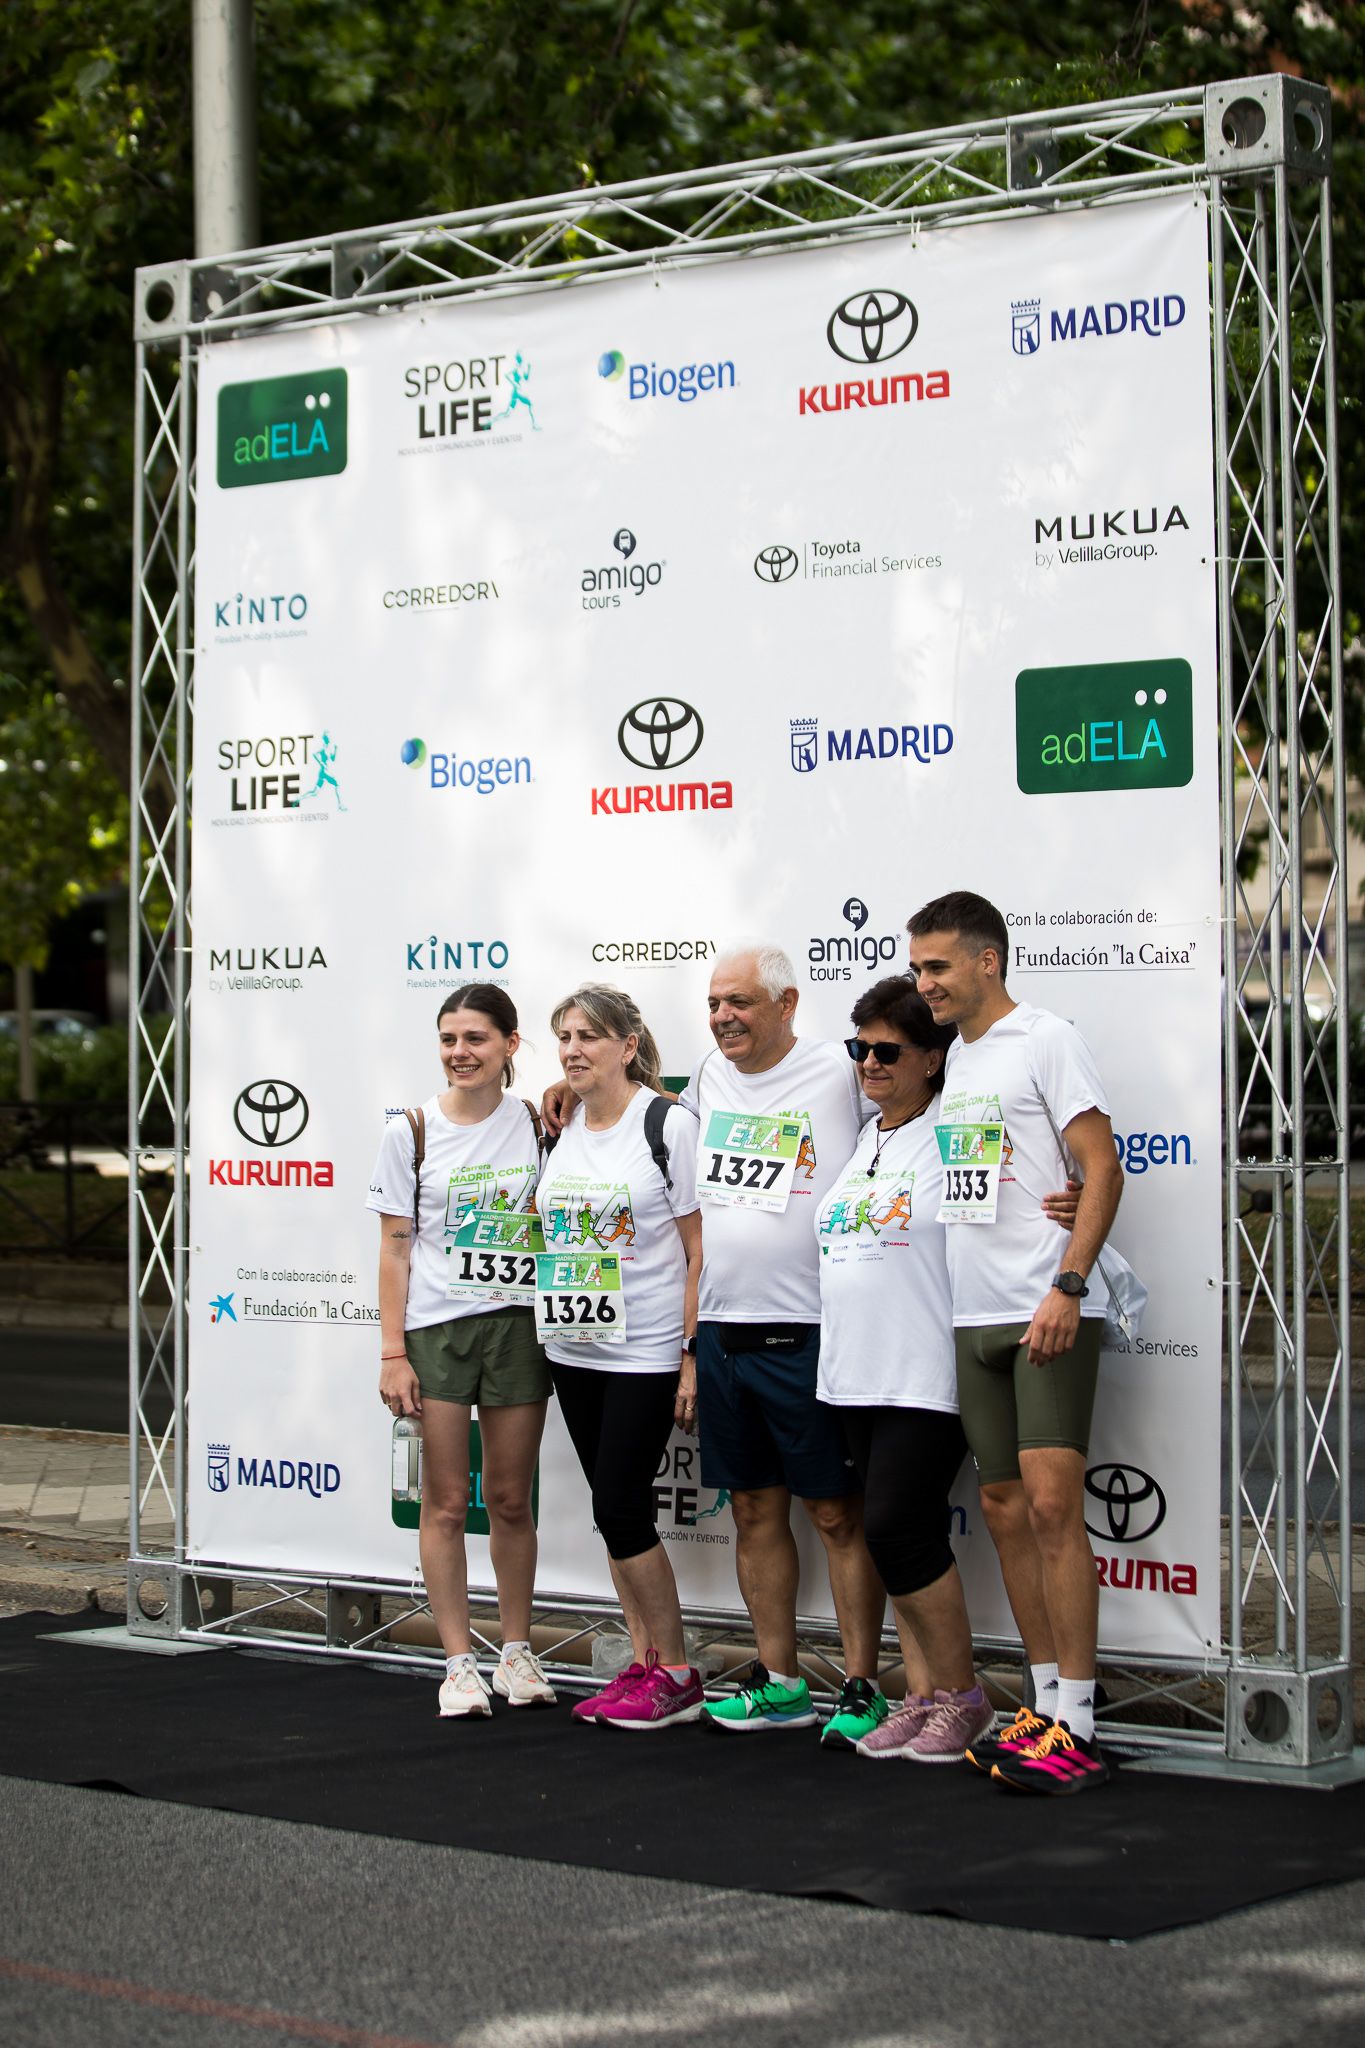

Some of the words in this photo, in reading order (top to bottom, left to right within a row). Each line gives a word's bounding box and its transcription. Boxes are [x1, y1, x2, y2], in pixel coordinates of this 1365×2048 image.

[1050, 294, 1186, 342] MADRID
[404, 355, 506, 398] SPORT
[629, 360, 736, 402] Biogen
[419, 396, 492, 439] LIFE
[234, 419, 329, 466] adELA
[1035, 505, 1190, 543] MUKUA
[811, 540, 861, 559] Toyota
[1035, 551, 1054, 570] by
[1058, 543, 1158, 564] VelillaGroup.
[812, 558, 877, 578] Financial
[881, 554, 942, 572] Services
[582, 595, 621, 610] tours
[218, 735, 314, 770] SPORT
[827, 723, 954, 764] MADRID
[1041, 718, 1168, 766] adELA
[430, 753, 532, 794] Biogen
[231, 774, 300, 811] LIFE
[1006, 912, 1031, 926] Con
[1035, 911, 1046, 925] la
[1050, 909, 1133, 925] colaboración
[1137, 909, 1157, 923] de:
[210, 946, 328, 971] MUKUA
[1015, 946, 1109, 967] Fundación
[209, 977, 224, 994] by
[227, 975, 303, 992] VelillaGroup.
[407, 978, 437, 988] Flexible
[810, 966, 852, 981] tours
[967, 1095, 984, 1107] CON
[986, 1094, 1000, 1103] LA
[794, 1111, 810, 1119] LA
[724, 1122, 781, 1152] ELA
[949, 1133, 984, 1160] ELA
[1113, 1131, 1191, 1174] gen
[449, 1171, 495, 1185] MADRID
[497, 1166, 523, 1177] CON
[526, 1164, 537, 1173] LA
[461, 1163, 491, 1173] Carrera
[706, 1153, 786, 1190] 1327
[550, 1180, 588, 1190] MADRID
[589, 1183, 612, 1191] CON
[613, 1183, 629, 1191] LA
[945, 1169, 990, 1201] 1333
[541, 1189, 636, 1233] ELA
[472, 1220, 529, 1248] ELA
[237, 1268, 257, 1280] Con
[260, 1268, 269, 1281] la
[272, 1269, 337, 1283] colaboración
[341, 1271, 357, 1284] de:
[459, 1251, 536, 1286] 1332
[552, 1261, 602, 1287] ELA
[243, 1297, 317, 1318] Fundación
[543, 1295, 616, 1324] 1326
[1135, 1337, 1198, 1358] Services
[237, 1457, 341, 1499] MADRID
[652, 1486, 698, 1526] FE
[690, 1532, 695, 1541] Y
[696, 1533, 730, 1545] EVENTOS
